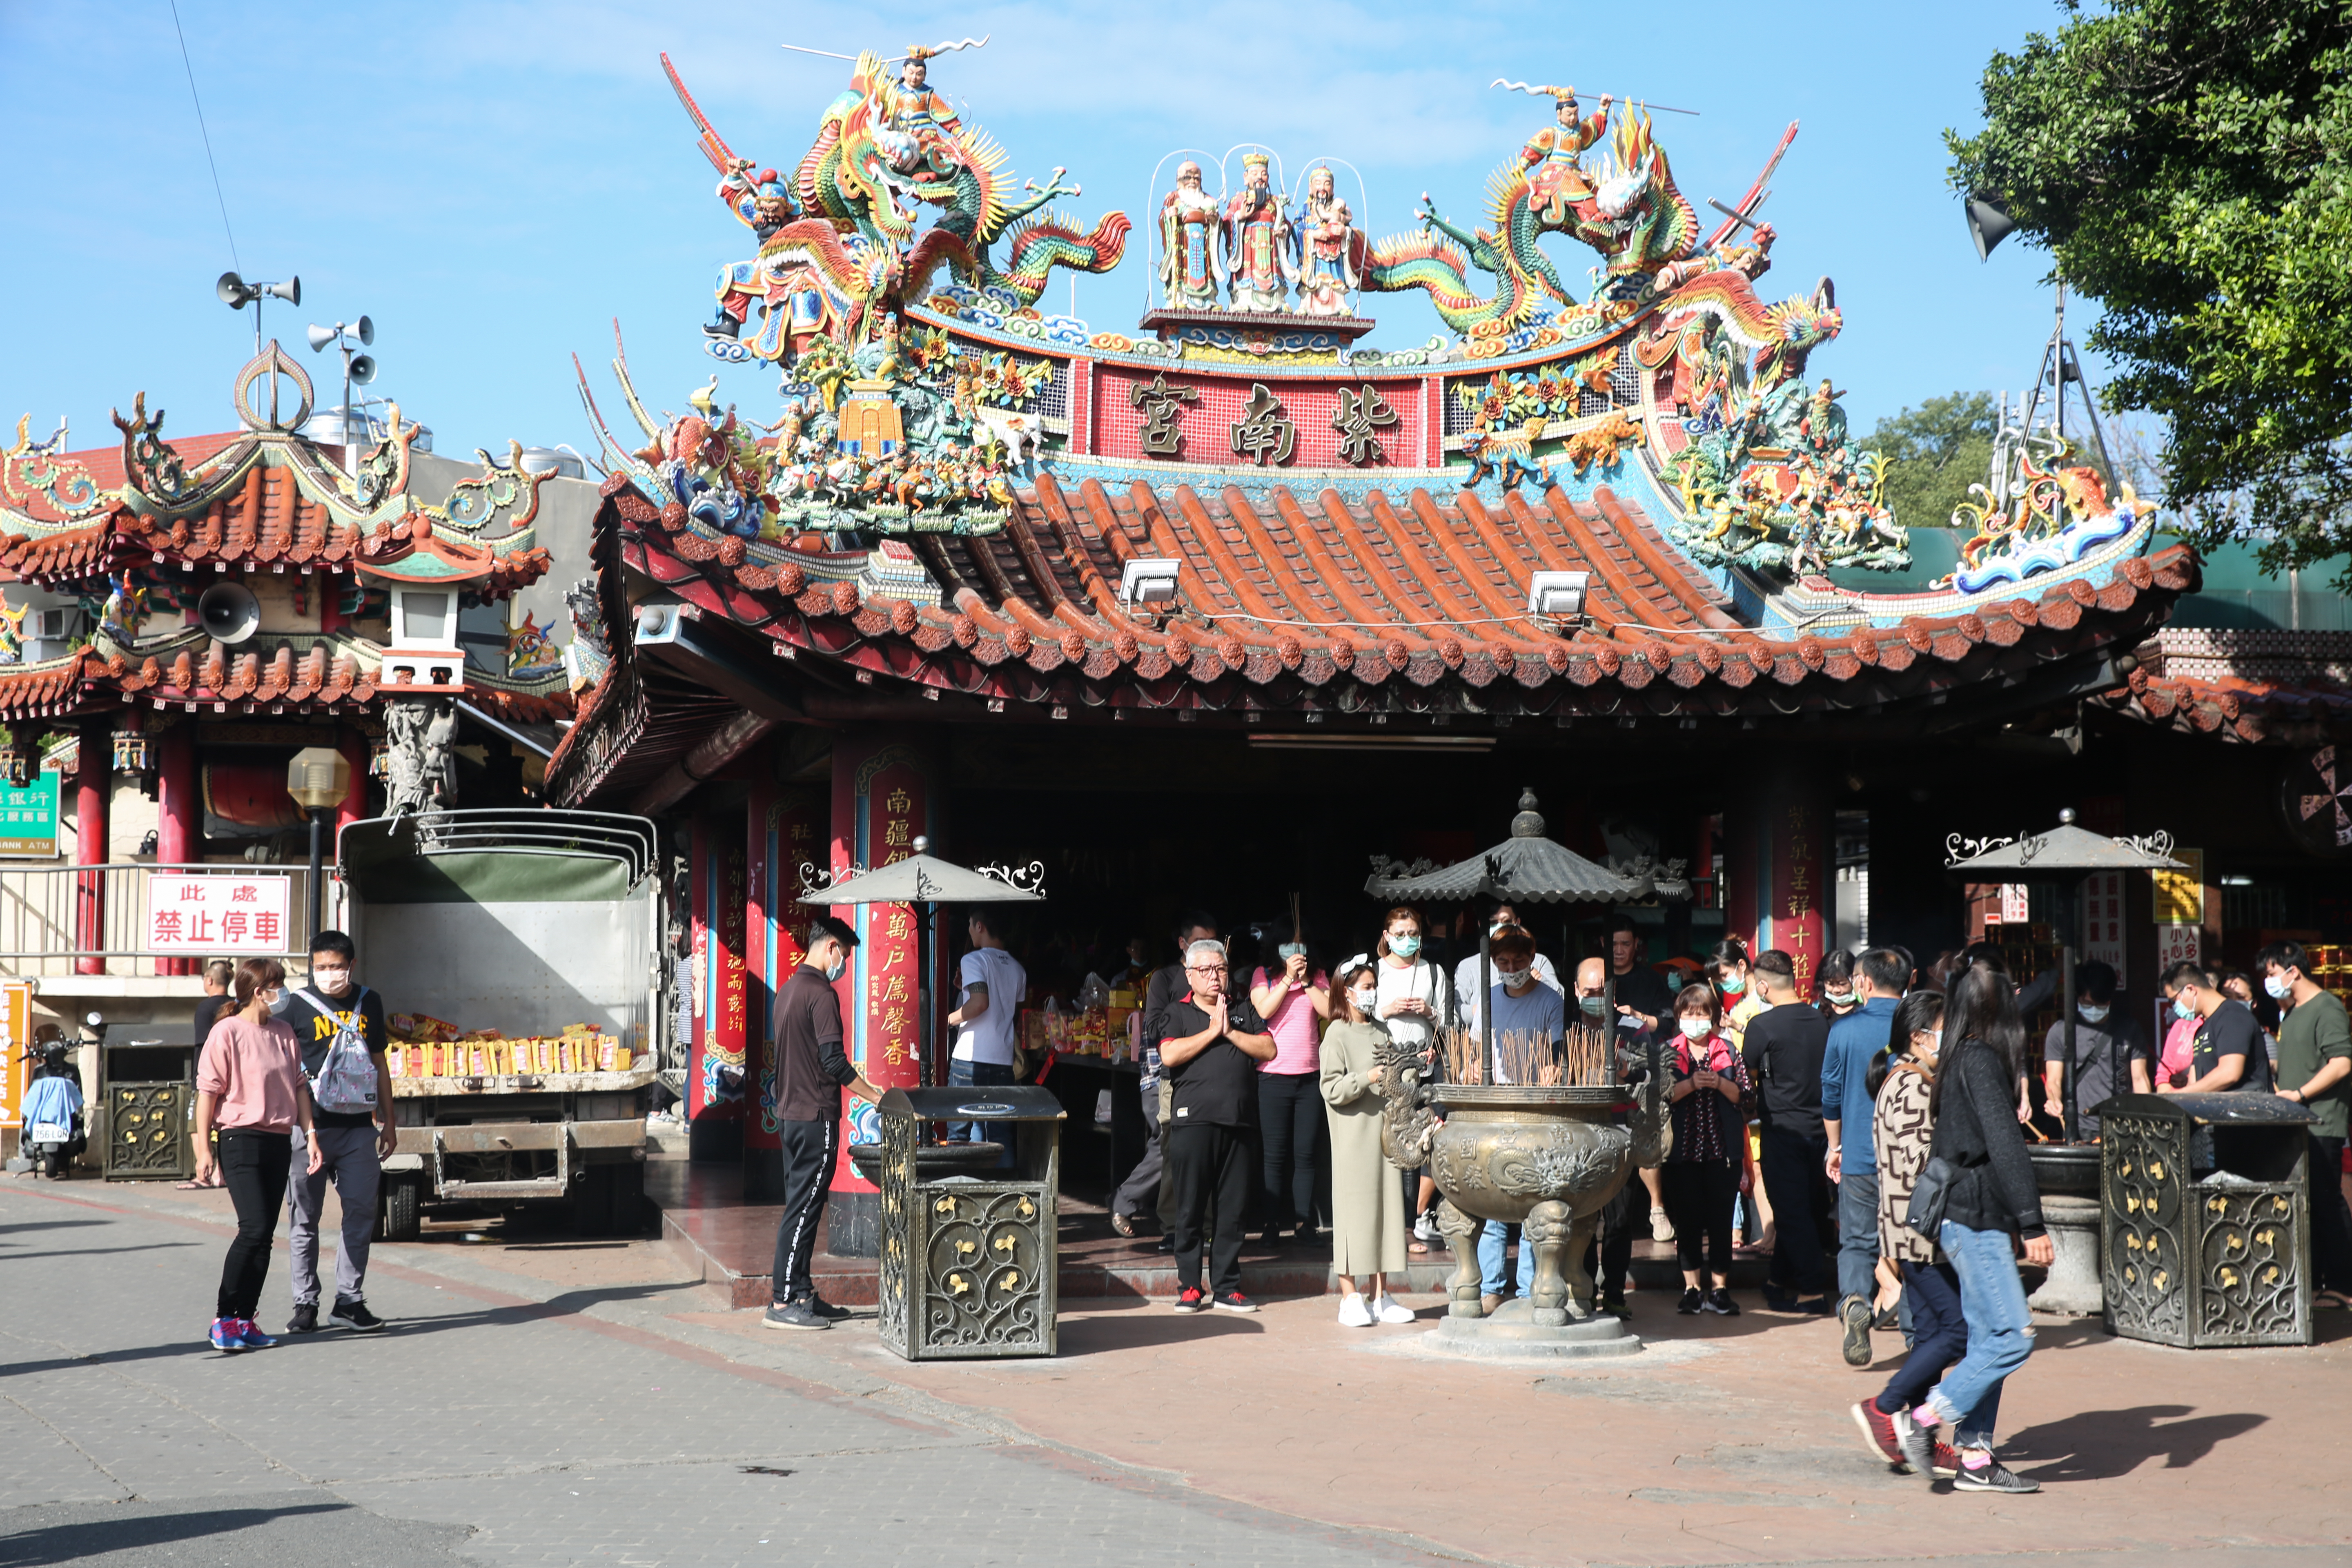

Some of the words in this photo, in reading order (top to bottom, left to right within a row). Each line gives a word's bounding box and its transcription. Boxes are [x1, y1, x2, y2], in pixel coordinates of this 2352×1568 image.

[1129, 376, 1397, 465] 紫南宮
[180, 884, 257, 902] 此處
[155, 910, 280, 943] 禁止停車
[881, 788, 911, 1066] 南疆錫萬戶薦馨香
[2170, 929, 2183, 964] 小心
[2185, 928, 2197, 965] 人多
[785, 1252, 794, 1281] HEAD
[792, 1216, 805, 1251] JEANS
[802, 1186, 817, 1214] HEAD
[815, 1153, 828, 1186] JEANS
